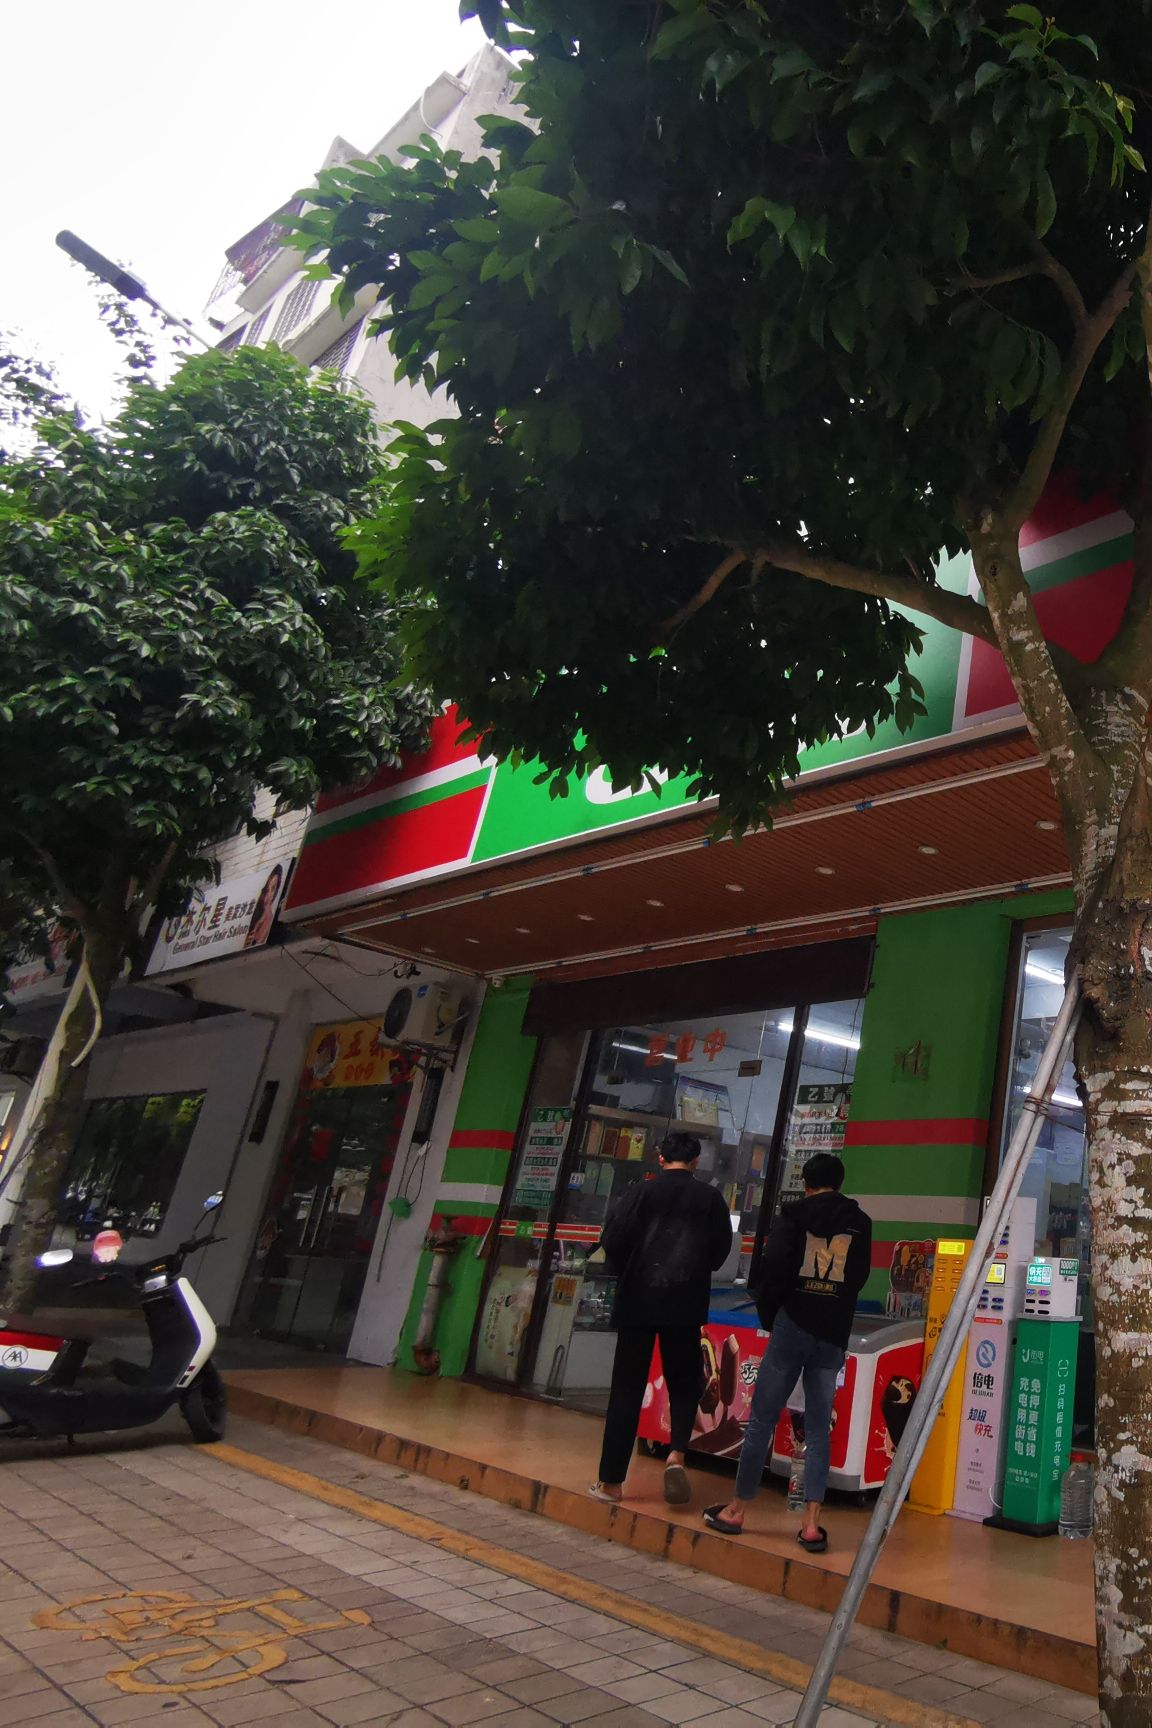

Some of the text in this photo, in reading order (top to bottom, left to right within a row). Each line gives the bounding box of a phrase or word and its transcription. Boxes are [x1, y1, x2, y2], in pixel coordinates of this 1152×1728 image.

[799, 1230, 852, 1282] M
[972, 1371, 994, 1391] 倍电
[967, 1407, 988, 1423] 超级
[1014, 1376, 1030, 1456] 充电用街电
[974, 1423, 994, 1439] 快充
